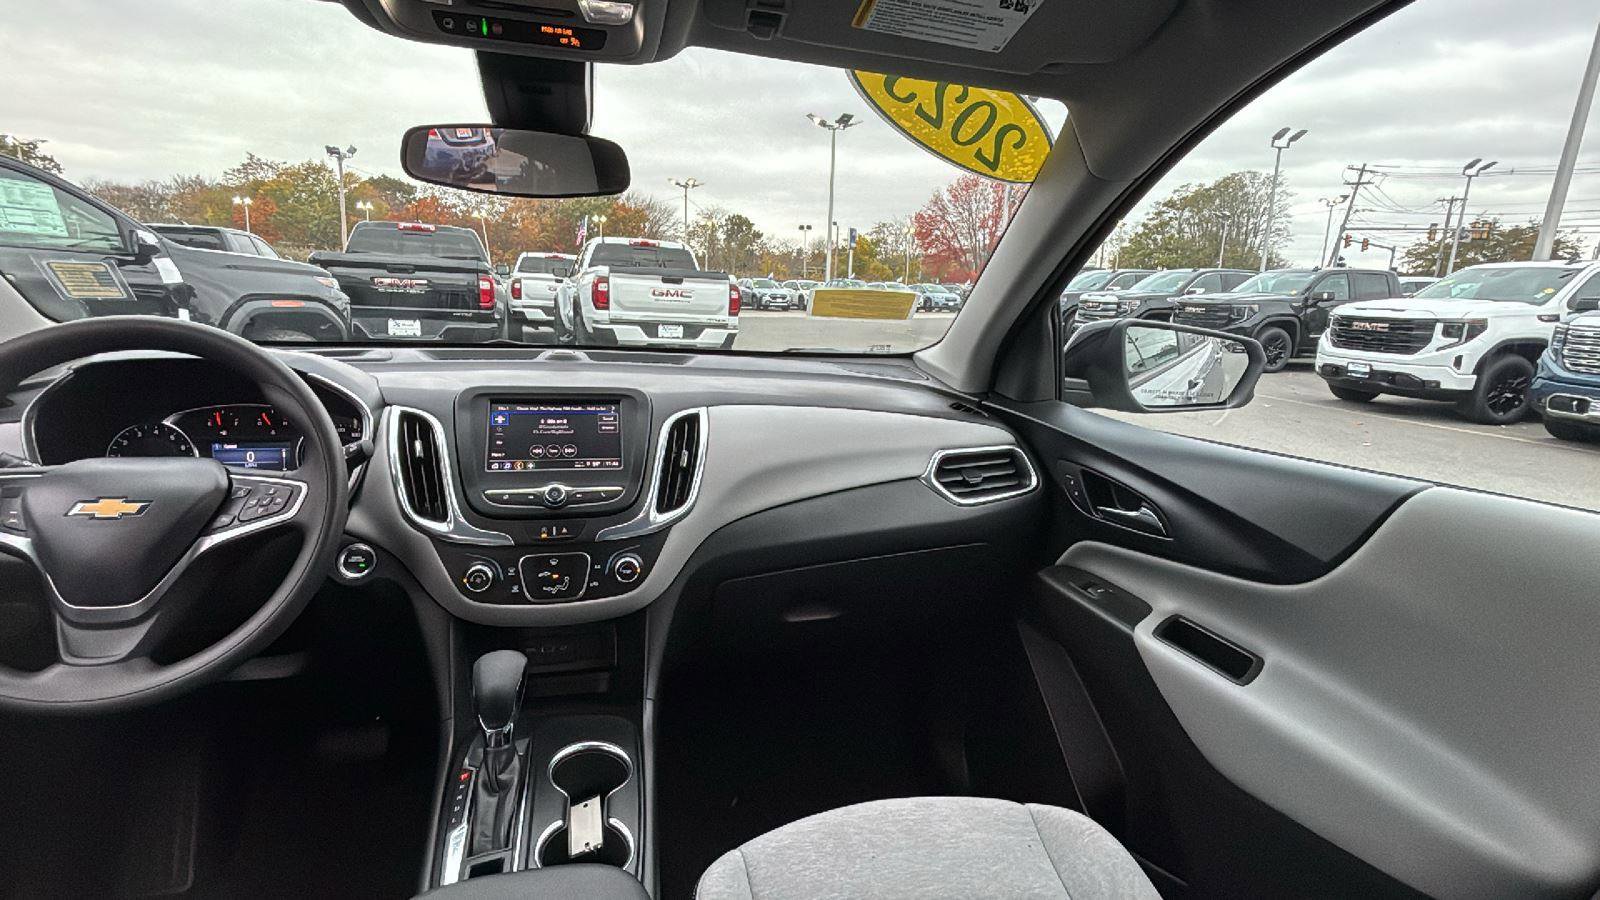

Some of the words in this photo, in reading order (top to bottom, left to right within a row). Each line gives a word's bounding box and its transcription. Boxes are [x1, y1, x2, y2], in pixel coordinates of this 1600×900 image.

[651, 288, 694, 299] GMC
[1351, 321, 1390, 332] GMC
[246, 451, 255, 463] 0
